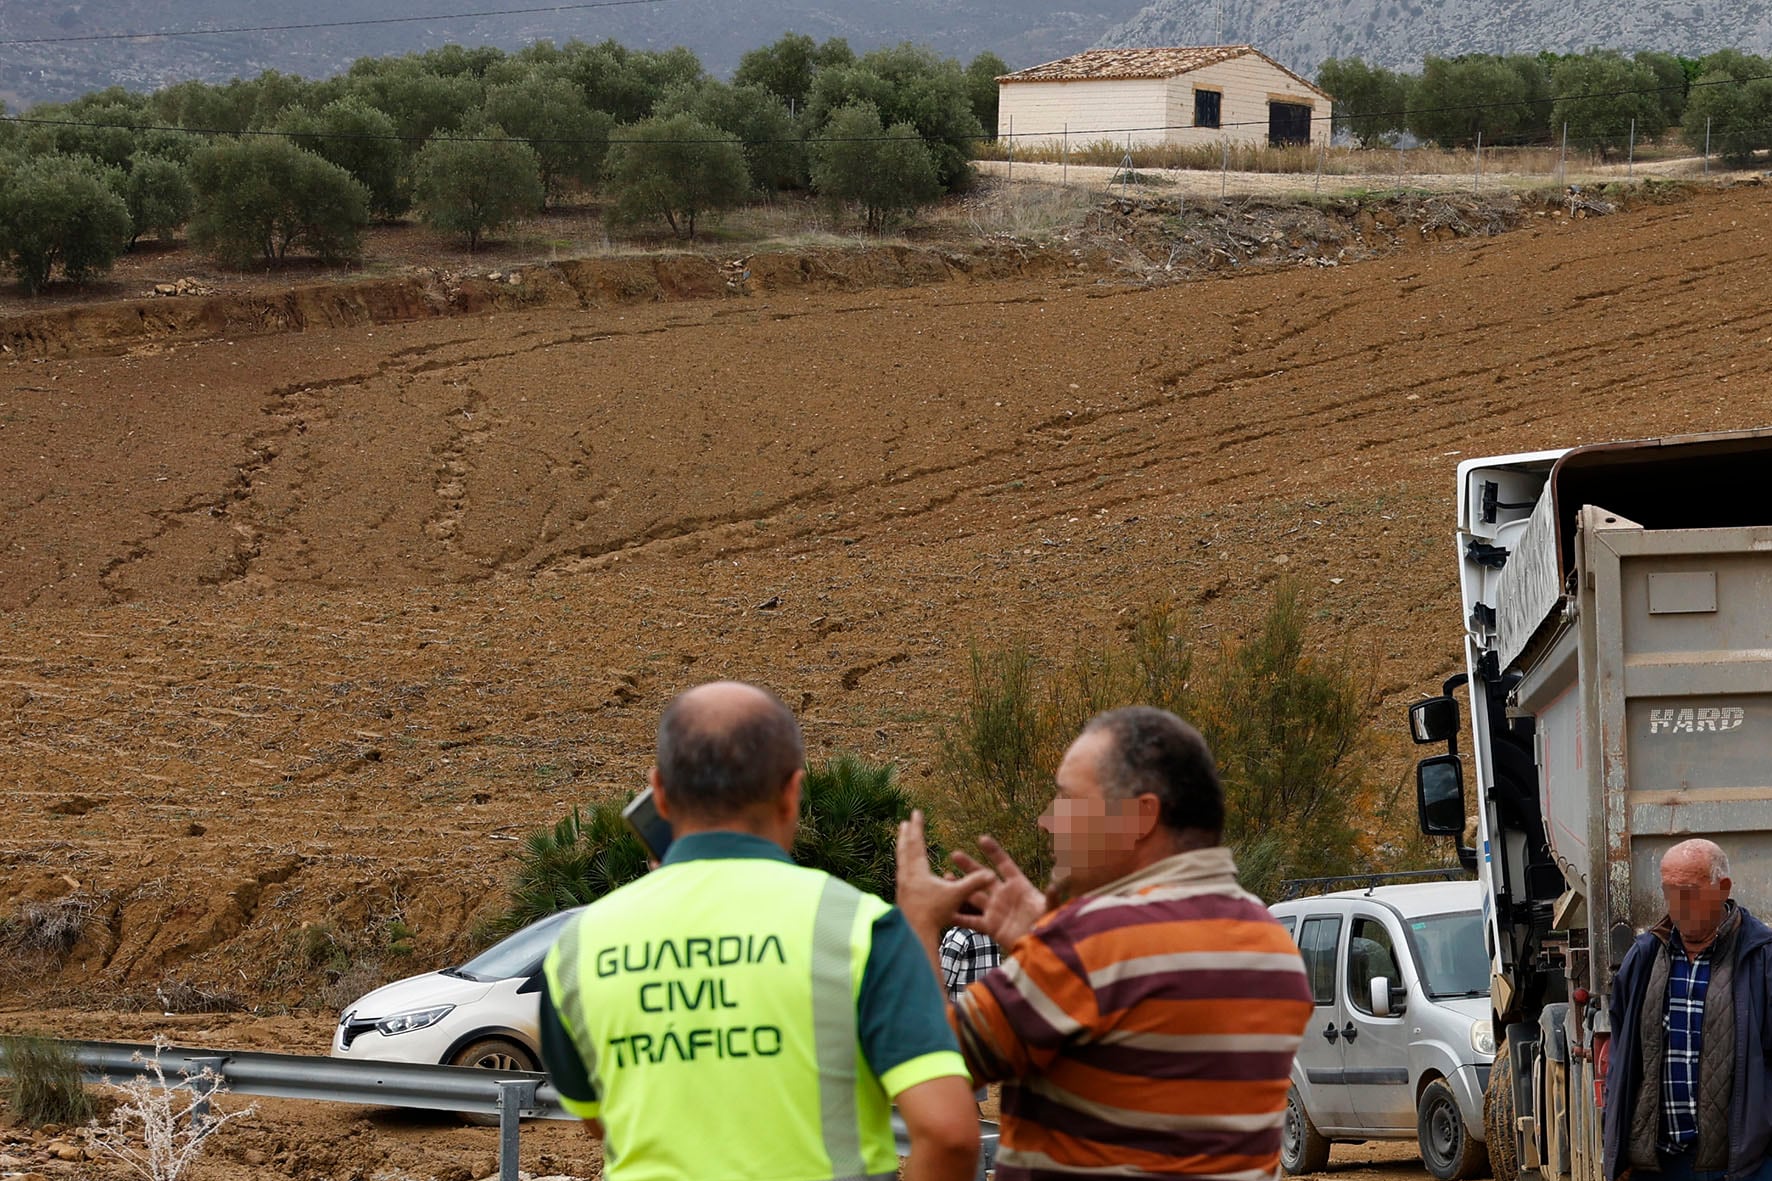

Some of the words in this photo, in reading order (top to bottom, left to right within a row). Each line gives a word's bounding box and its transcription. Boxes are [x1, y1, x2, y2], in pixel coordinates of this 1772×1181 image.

[1650, 707, 1745, 734] HARD
[597, 935, 787, 979] GUARDIA
[640, 978, 739, 1013] CIVIL
[609, 1022, 783, 1069] TRÁFICO
